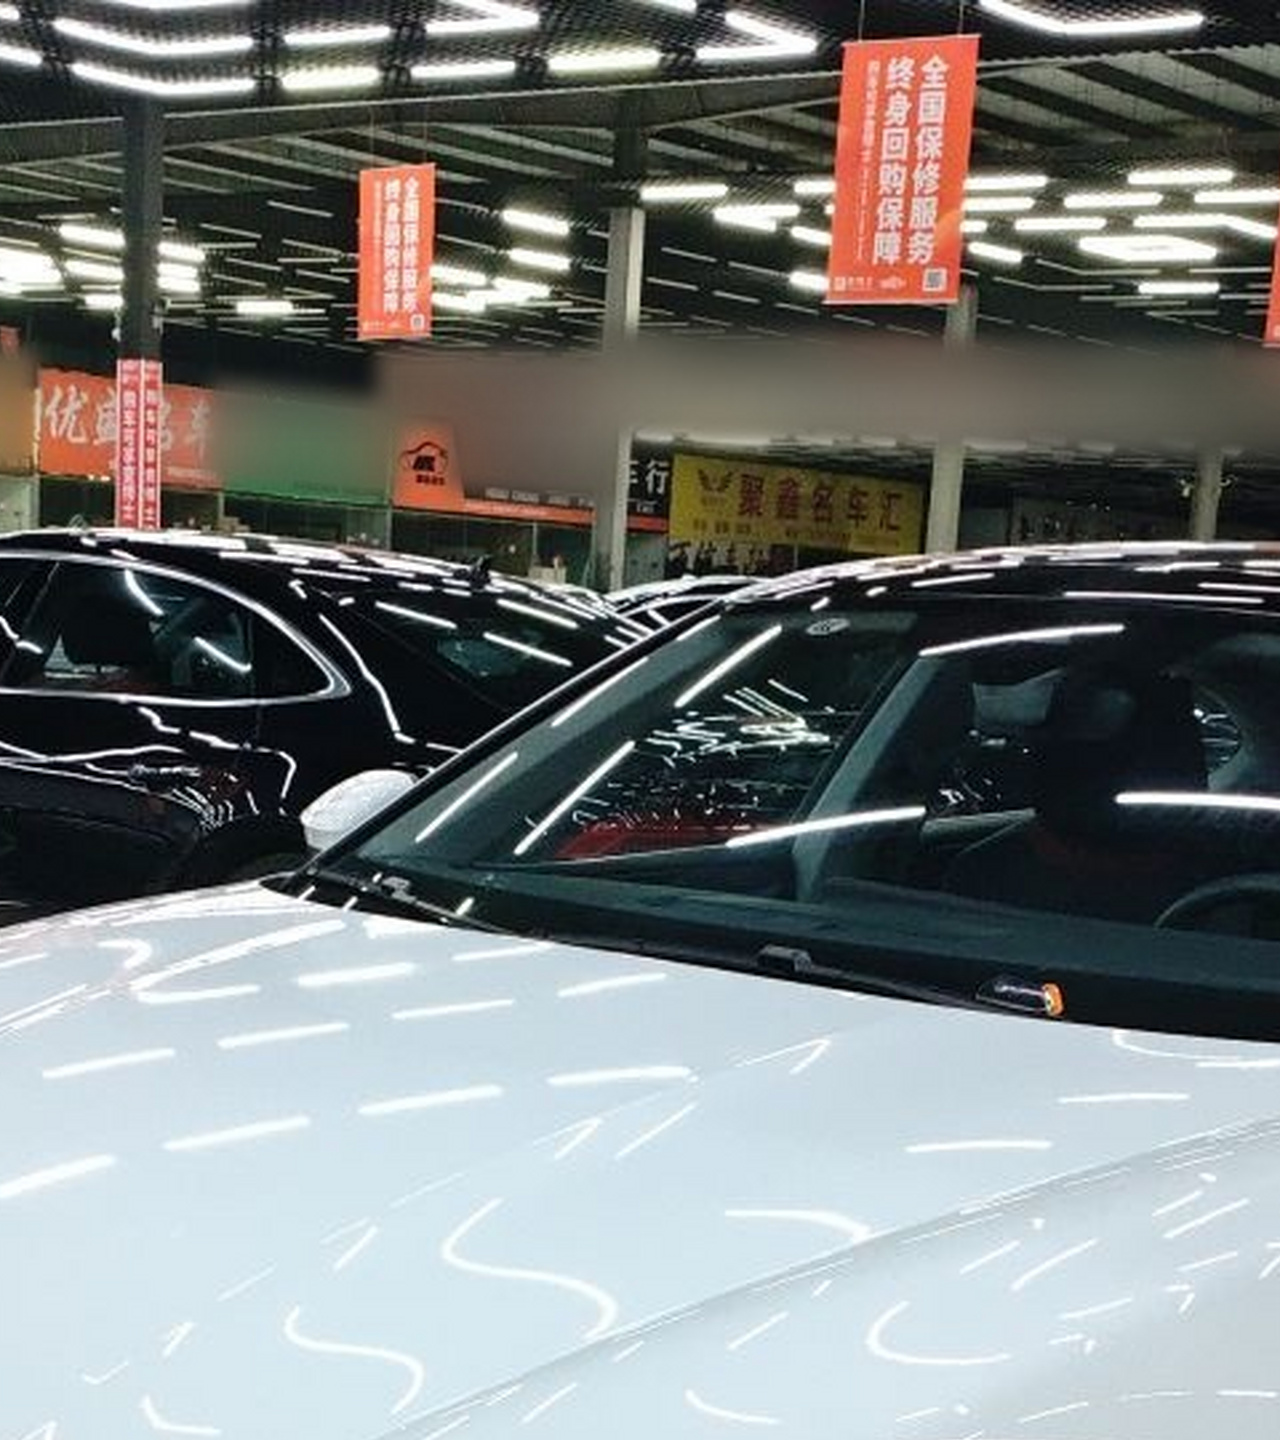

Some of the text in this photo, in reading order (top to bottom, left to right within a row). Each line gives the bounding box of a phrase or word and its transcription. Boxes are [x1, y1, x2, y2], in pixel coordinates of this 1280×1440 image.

[872, 57, 917, 266] 终身回购保障
[907, 54, 949, 265] 全国保修服务
